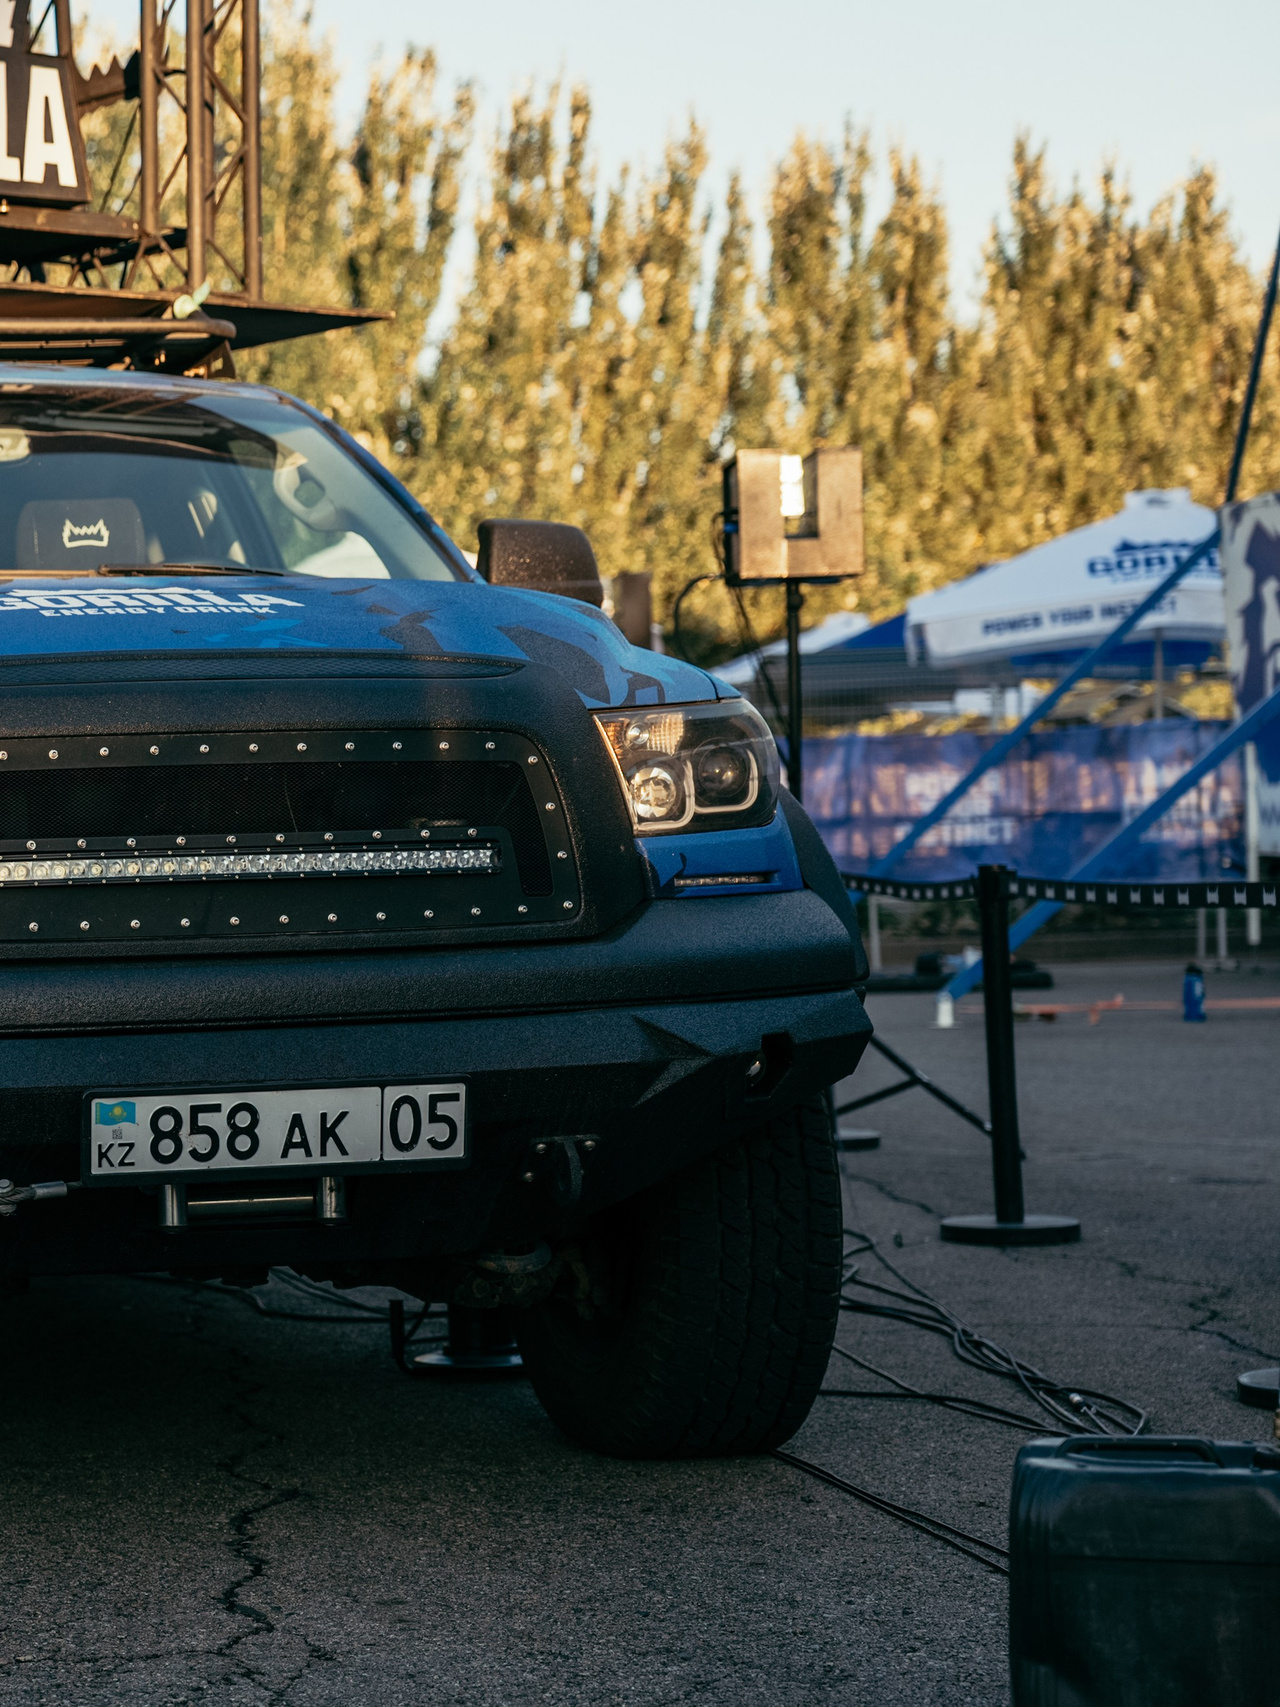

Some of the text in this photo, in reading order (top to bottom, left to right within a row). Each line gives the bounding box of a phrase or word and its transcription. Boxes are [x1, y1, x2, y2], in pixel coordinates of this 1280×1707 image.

[39, 605, 279, 618] ENERGY DRINK
[149, 1092, 461, 1164] 858 AK 05
[97, 1142, 135, 1168] KZ
